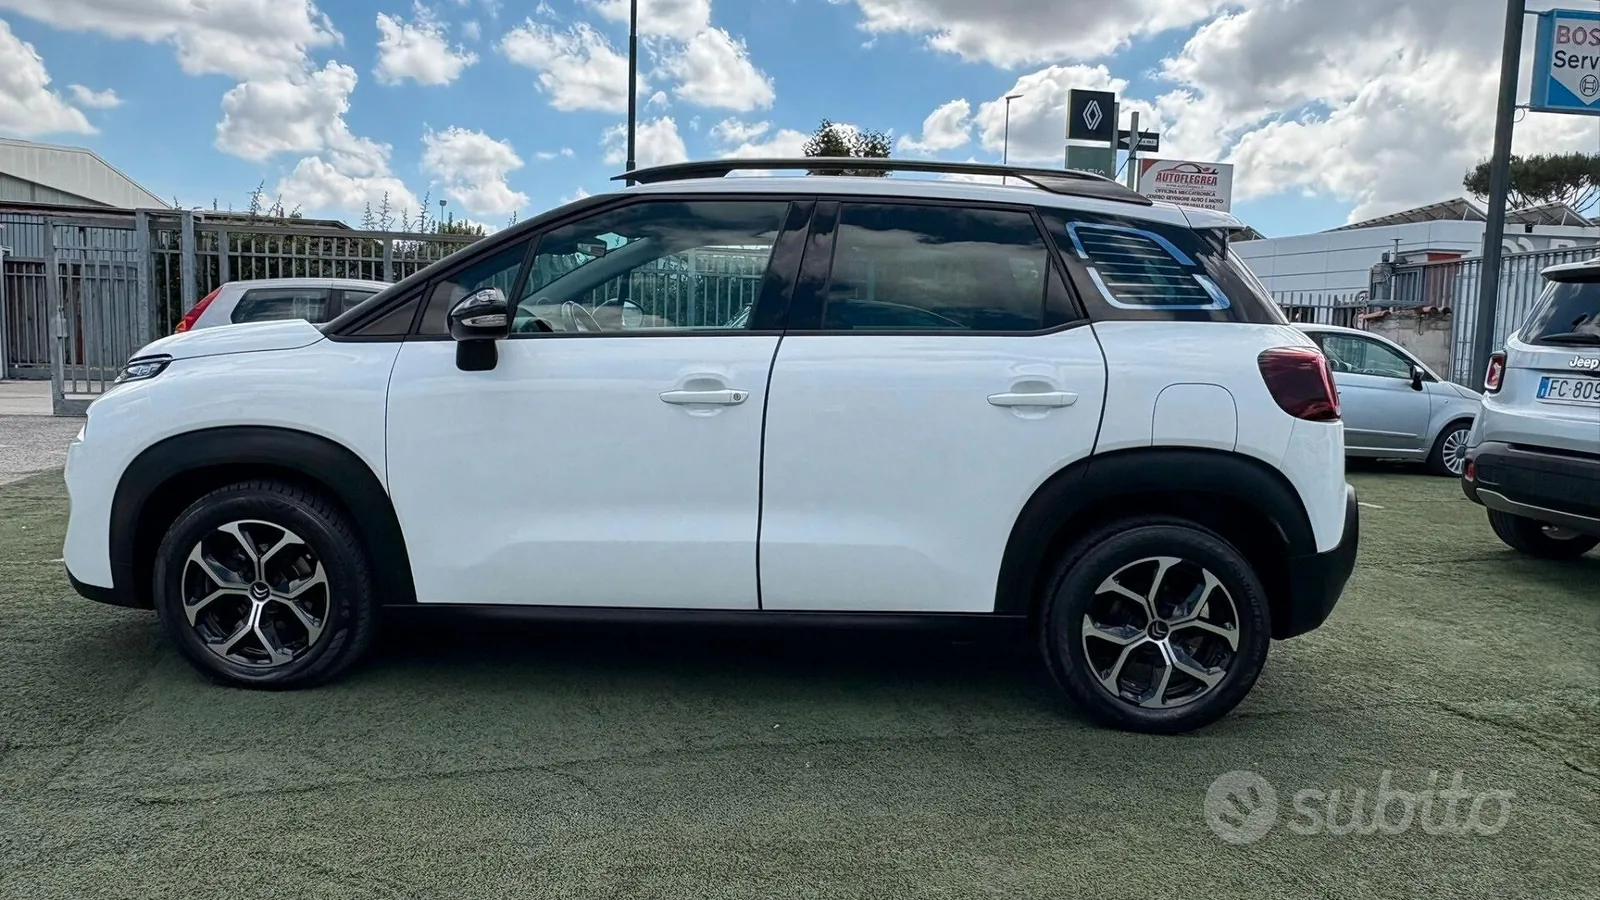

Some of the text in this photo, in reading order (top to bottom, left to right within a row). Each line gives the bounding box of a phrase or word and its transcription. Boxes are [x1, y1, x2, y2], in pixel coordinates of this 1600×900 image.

[1556, 25, 1600, 46] BOS
[1553, 50, 1600, 70] Serv
[1155, 172, 1218, 186] AUTOFLEGREA
[1178, 189, 1216, 197] MECCATRONICA
[1569, 355, 1600, 370] Jeep
[1548, 380, 1600, 400] FC 809
